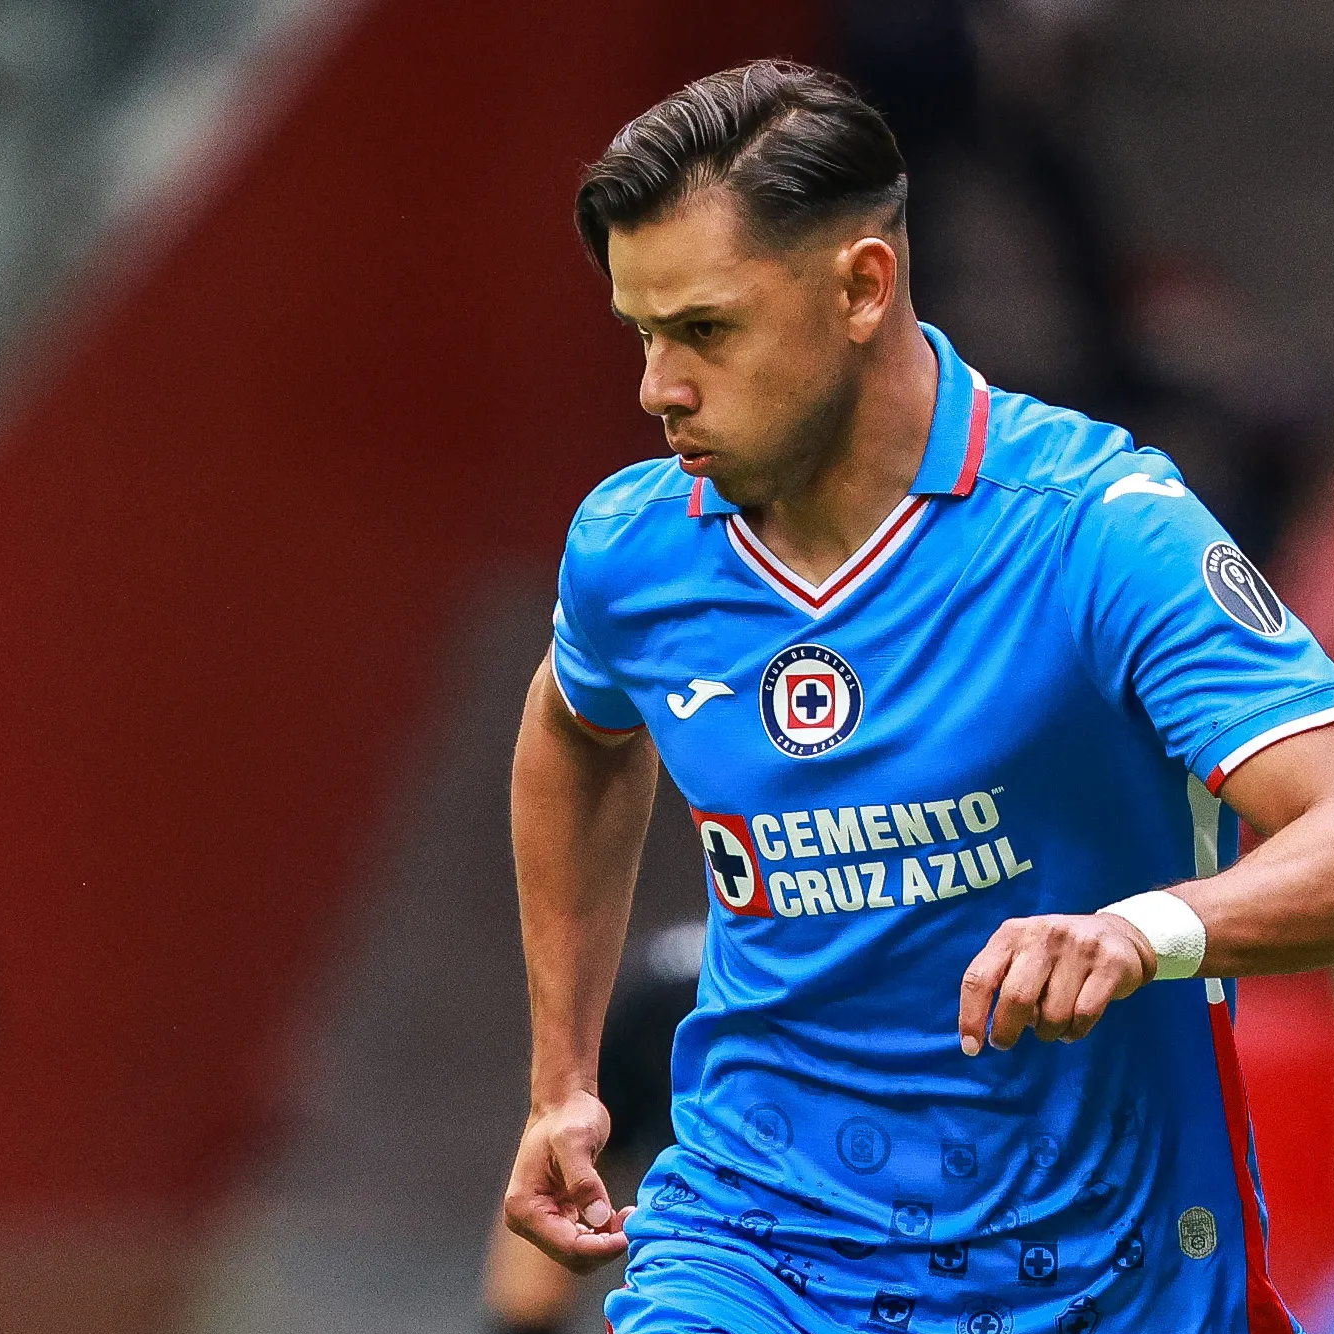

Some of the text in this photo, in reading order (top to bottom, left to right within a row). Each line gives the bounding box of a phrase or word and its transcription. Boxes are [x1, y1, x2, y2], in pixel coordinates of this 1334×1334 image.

[1229, 565, 1245, 584] 9
[765, 650, 856, 692] CLUB DE FUTBOL
[776, 734, 843, 755] CRUZ AZUL
[751, 791, 1000, 861] CEMENTO
[768, 836, 1033, 918] CRUZ AZUL
